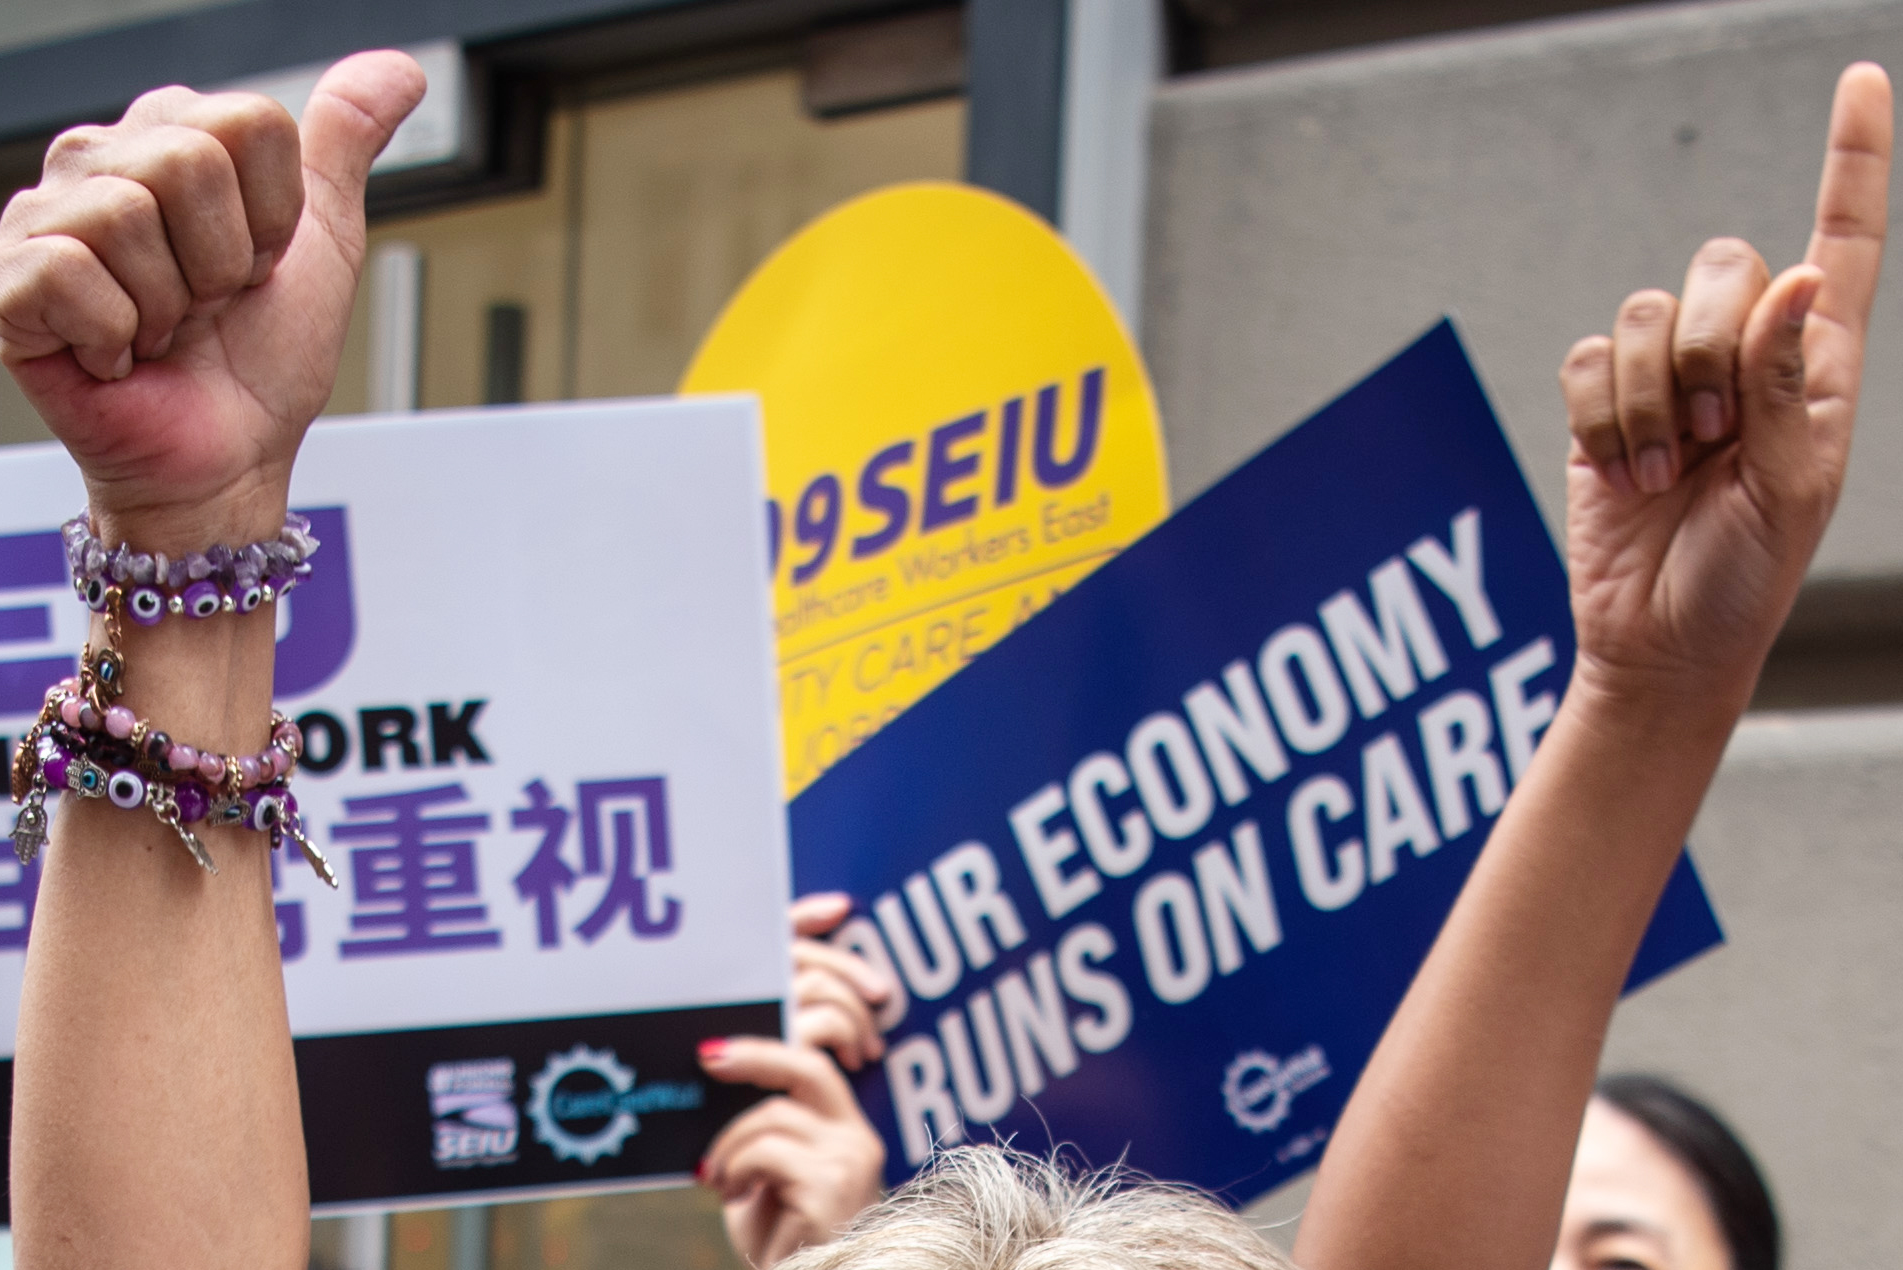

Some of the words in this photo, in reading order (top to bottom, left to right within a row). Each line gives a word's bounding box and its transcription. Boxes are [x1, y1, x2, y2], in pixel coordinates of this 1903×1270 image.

[899, 522, 1031, 588] Workers
[1040, 490, 1112, 545] East
[852, 605, 991, 694] CARE
[300, 699, 491, 774] ORK
[1008, 506, 1505, 919] ECONOMY
[883, 923, 1134, 1168] RUNS
[1132, 820, 1284, 1005] ON
[1289, 636, 1556, 911] CARE
